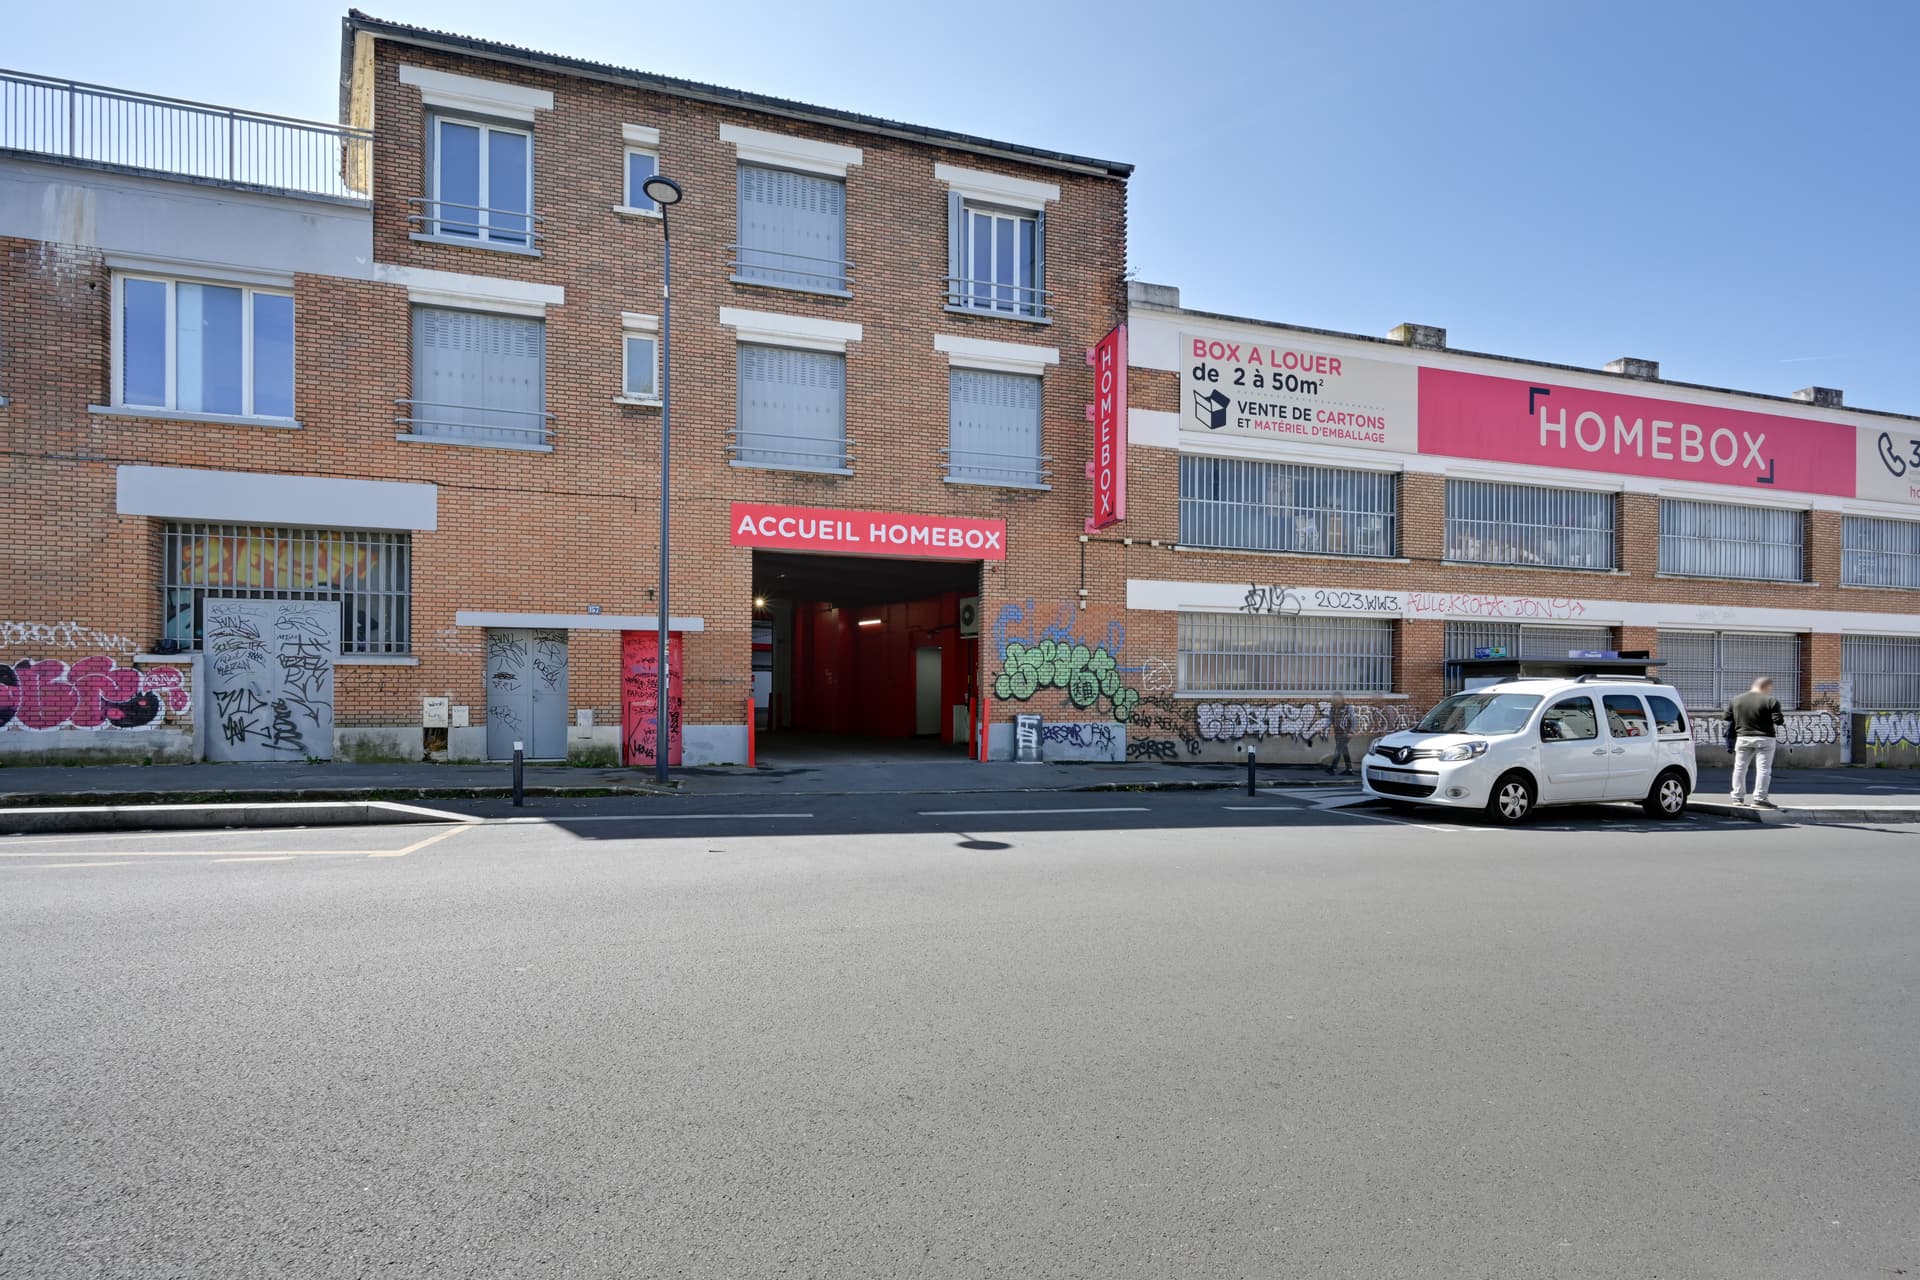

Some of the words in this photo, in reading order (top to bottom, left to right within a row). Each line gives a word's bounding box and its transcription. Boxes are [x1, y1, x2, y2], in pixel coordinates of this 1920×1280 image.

[1192, 362, 1219, 383] de
[1233, 367, 1246, 386] 2
[1253, 368, 1265, 389] à
[1193, 339, 1240, 363] BOX
[1248, 346, 1263, 366] A
[1271, 349, 1342, 377] LOUER
[1100, 345, 1112, 515] HOMEBOX
[1237, 400, 1288, 419] VENTE
[1292, 406, 1312, 422] DE
[1316, 409, 1385, 430] CARTONS
[1237, 417, 1251, 429] ET
[1254, 418, 1308, 436] MATÉRIEL
[1311, 425, 1385, 443] D'EMBALLAGE
[1539, 406, 1766, 470] HOMEBOX
[737, 514, 860, 542] ACCUEIL
[869, 523, 1001, 550] HOMEBOX
